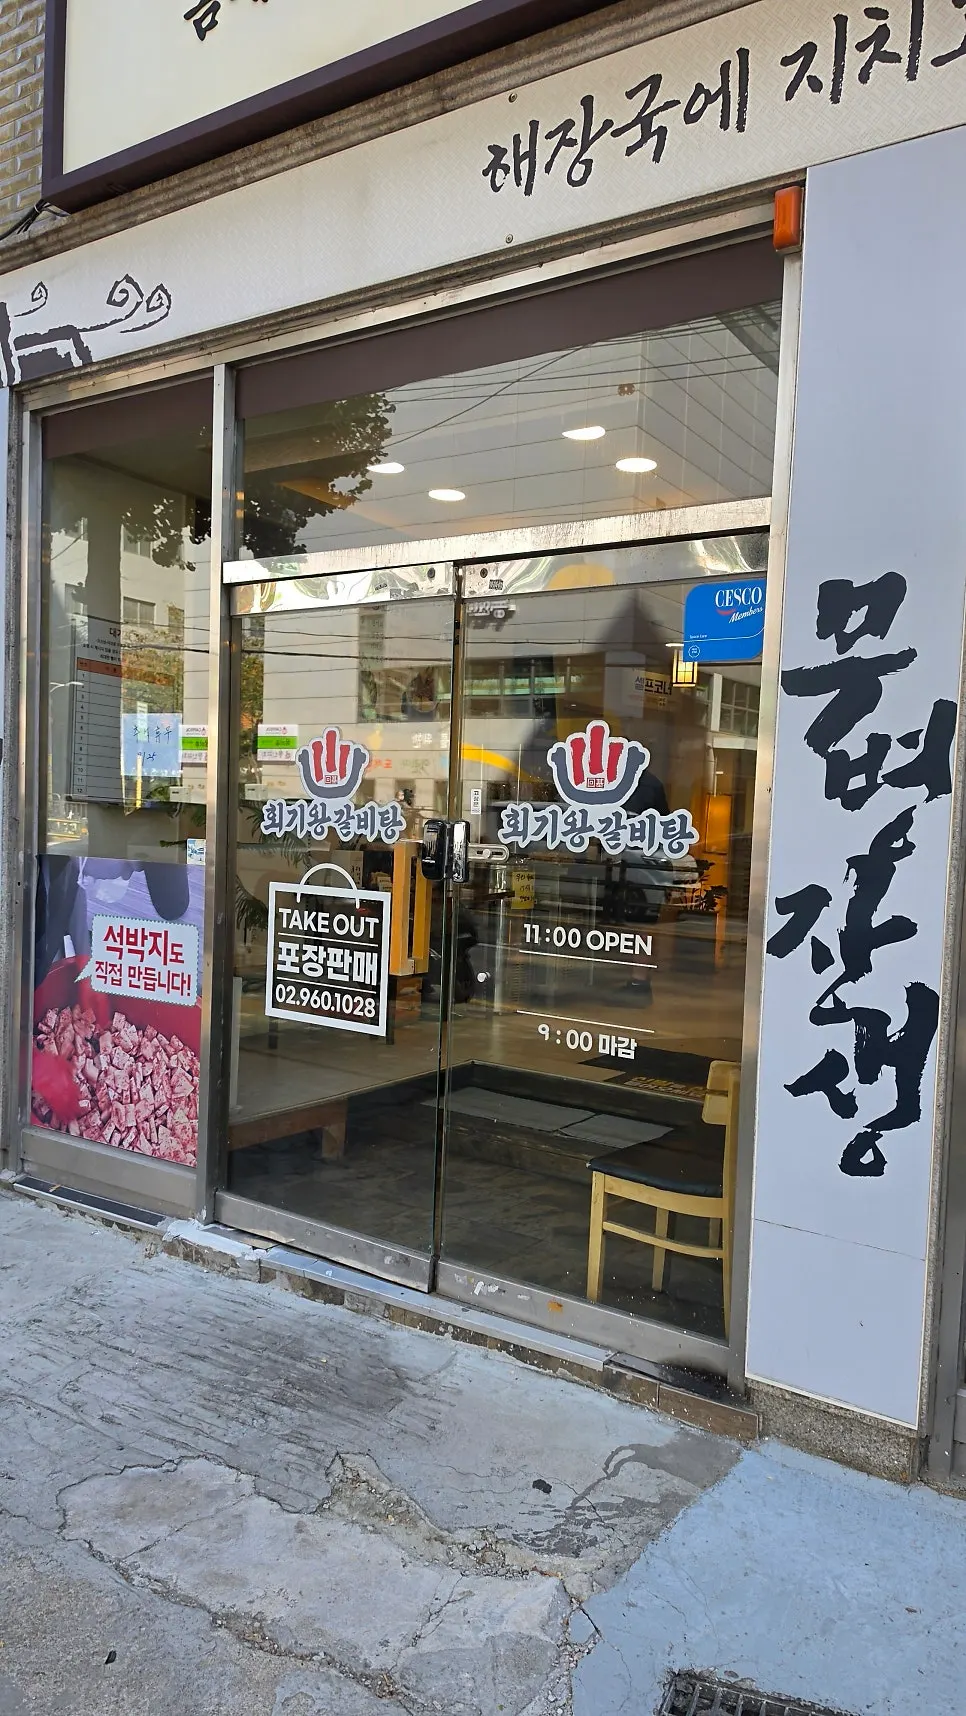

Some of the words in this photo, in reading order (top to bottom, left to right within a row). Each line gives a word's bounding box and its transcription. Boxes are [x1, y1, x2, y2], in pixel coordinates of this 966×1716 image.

[482, 49, 750, 197] 해장국에
[715, 586, 763, 608] CESCO
[728, 605, 764, 624] Members
[263, 801, 404, 840] 회기왕갈비탕
[501, 806, 695, 855] 회기왕갈비탕
[278, 908, 330, 934] TAKE
[333, 914, 380, 939] OUT
[103, 925, 184, 966] 석박지도
[587, 930, 653, 956] OPEN
[95, 961, 122, 987] 직접
[128, 966, 192, 996] 만듭니다!
[276, 940, 378, 987] 포장판매
[275, 983, 376, 1018] 02.960.1028
[598, 1033, 638, 1060] 마감
